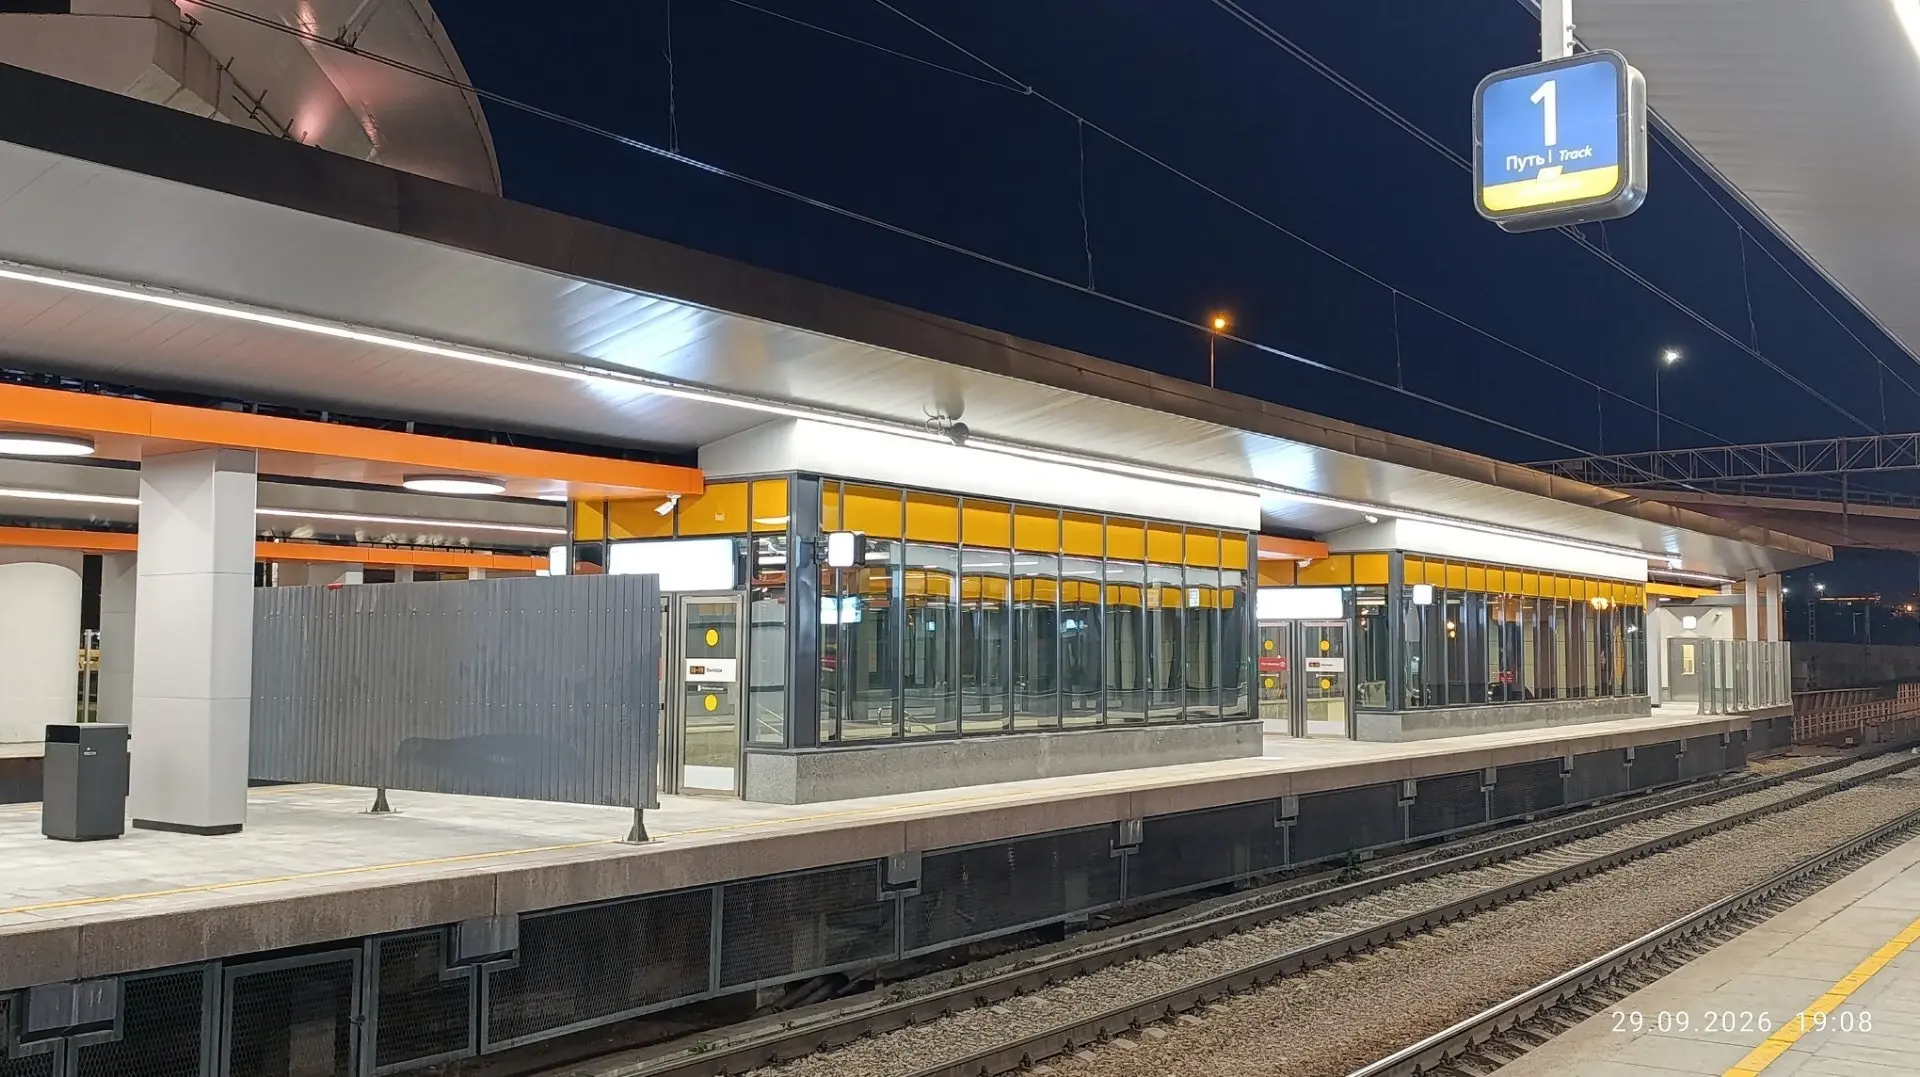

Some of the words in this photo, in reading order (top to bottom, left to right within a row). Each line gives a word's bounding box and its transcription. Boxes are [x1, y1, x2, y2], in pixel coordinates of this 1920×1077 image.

[1530, 80, 1557, 147] 1
[1559, 145, 1592, 161] Track
[1506, 155, 1545, 173] Путь
